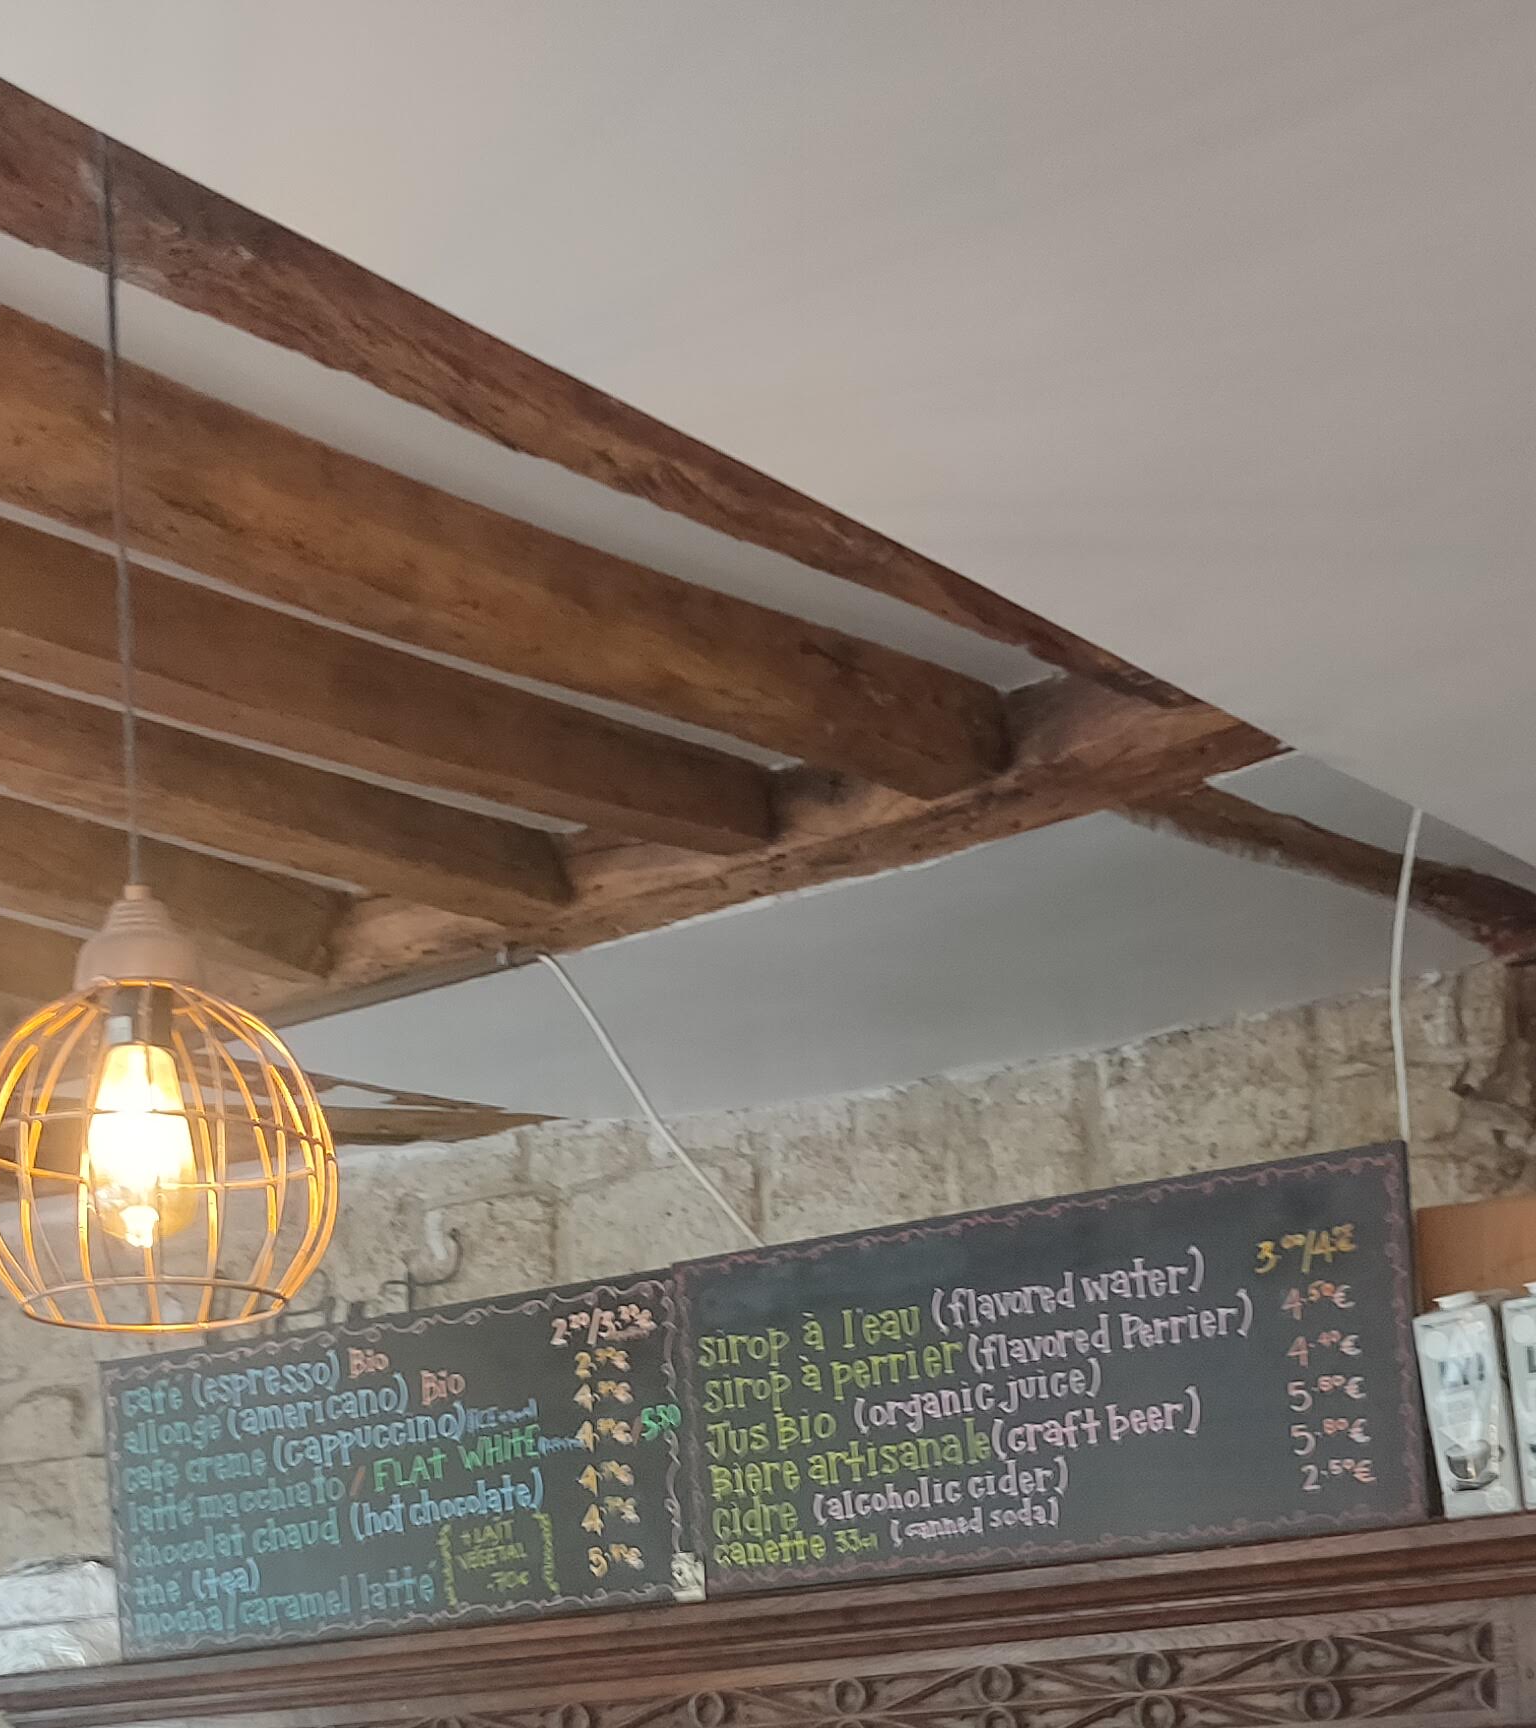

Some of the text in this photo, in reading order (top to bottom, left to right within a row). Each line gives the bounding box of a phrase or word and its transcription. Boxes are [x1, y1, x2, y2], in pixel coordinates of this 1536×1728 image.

[698, 1328, 790, 1368] sirop
[800, 1311, 826, 1350] à
[840, 1305, 921, 1350] l'eau
[931, 1271, 1076, 1336] (flavored
[1080, 1245, 1205, 1302] water)
[191, 1350, 340, 1408] (espresso)
[703, 1370, 792, 1413] sirop
[798, 1355, 824, 1392] à
[968, 1312, 1113, 1374] (flavored
[1119, 1288, 1254, 1350] Perrier)
[227, 1372, 409, 1440] (americano)
[854, 1380, 996, 1434] (organic
[997, 1356, 1102, 1414] juice)
[272, 1401, 464, 1473] (cappuccino)
[991, 1407, 1102, 1462] (craft
[349, 1494, 405, 1542] (hot
[409, 1466, 544, 1527] chocolate)
[814, 1475, 963, 1528] (alcoholic
[967, 1456, 1068, 1499] cider)
[191, 1557, 261, 1601] (tea)
